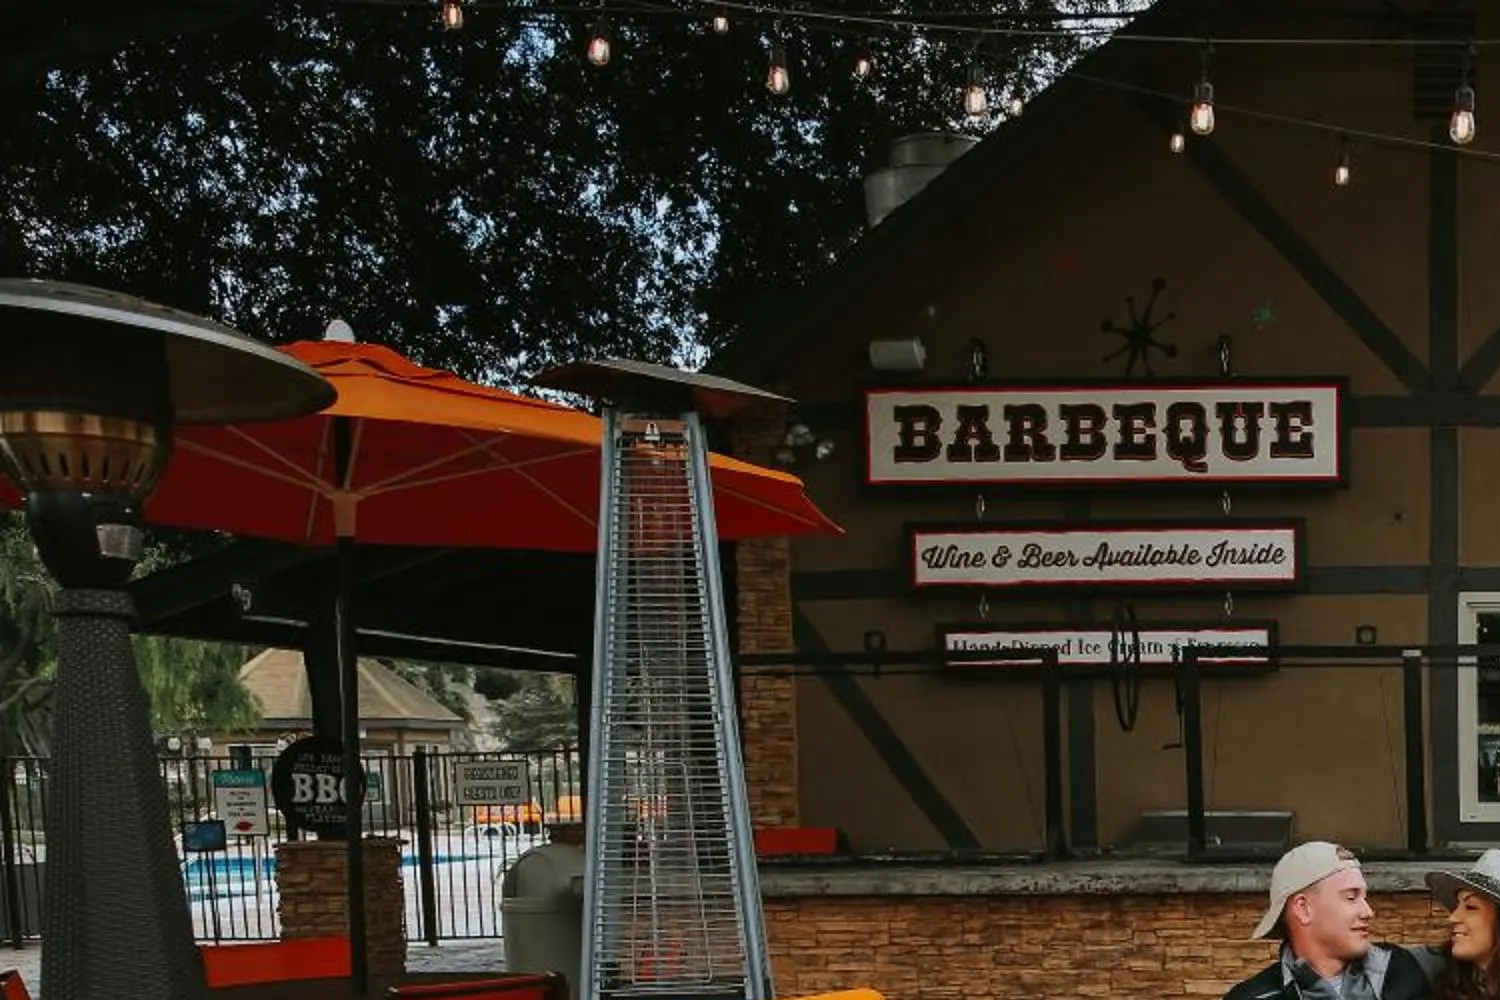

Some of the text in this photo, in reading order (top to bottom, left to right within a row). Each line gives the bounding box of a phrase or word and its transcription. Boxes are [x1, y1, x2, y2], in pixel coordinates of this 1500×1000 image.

[893, 401, 1315, 473] BARBEQUE
[921, 540, 1287, 572] Wine & Beer Available Inside
[1078, 638, 1102, 655] Ice
